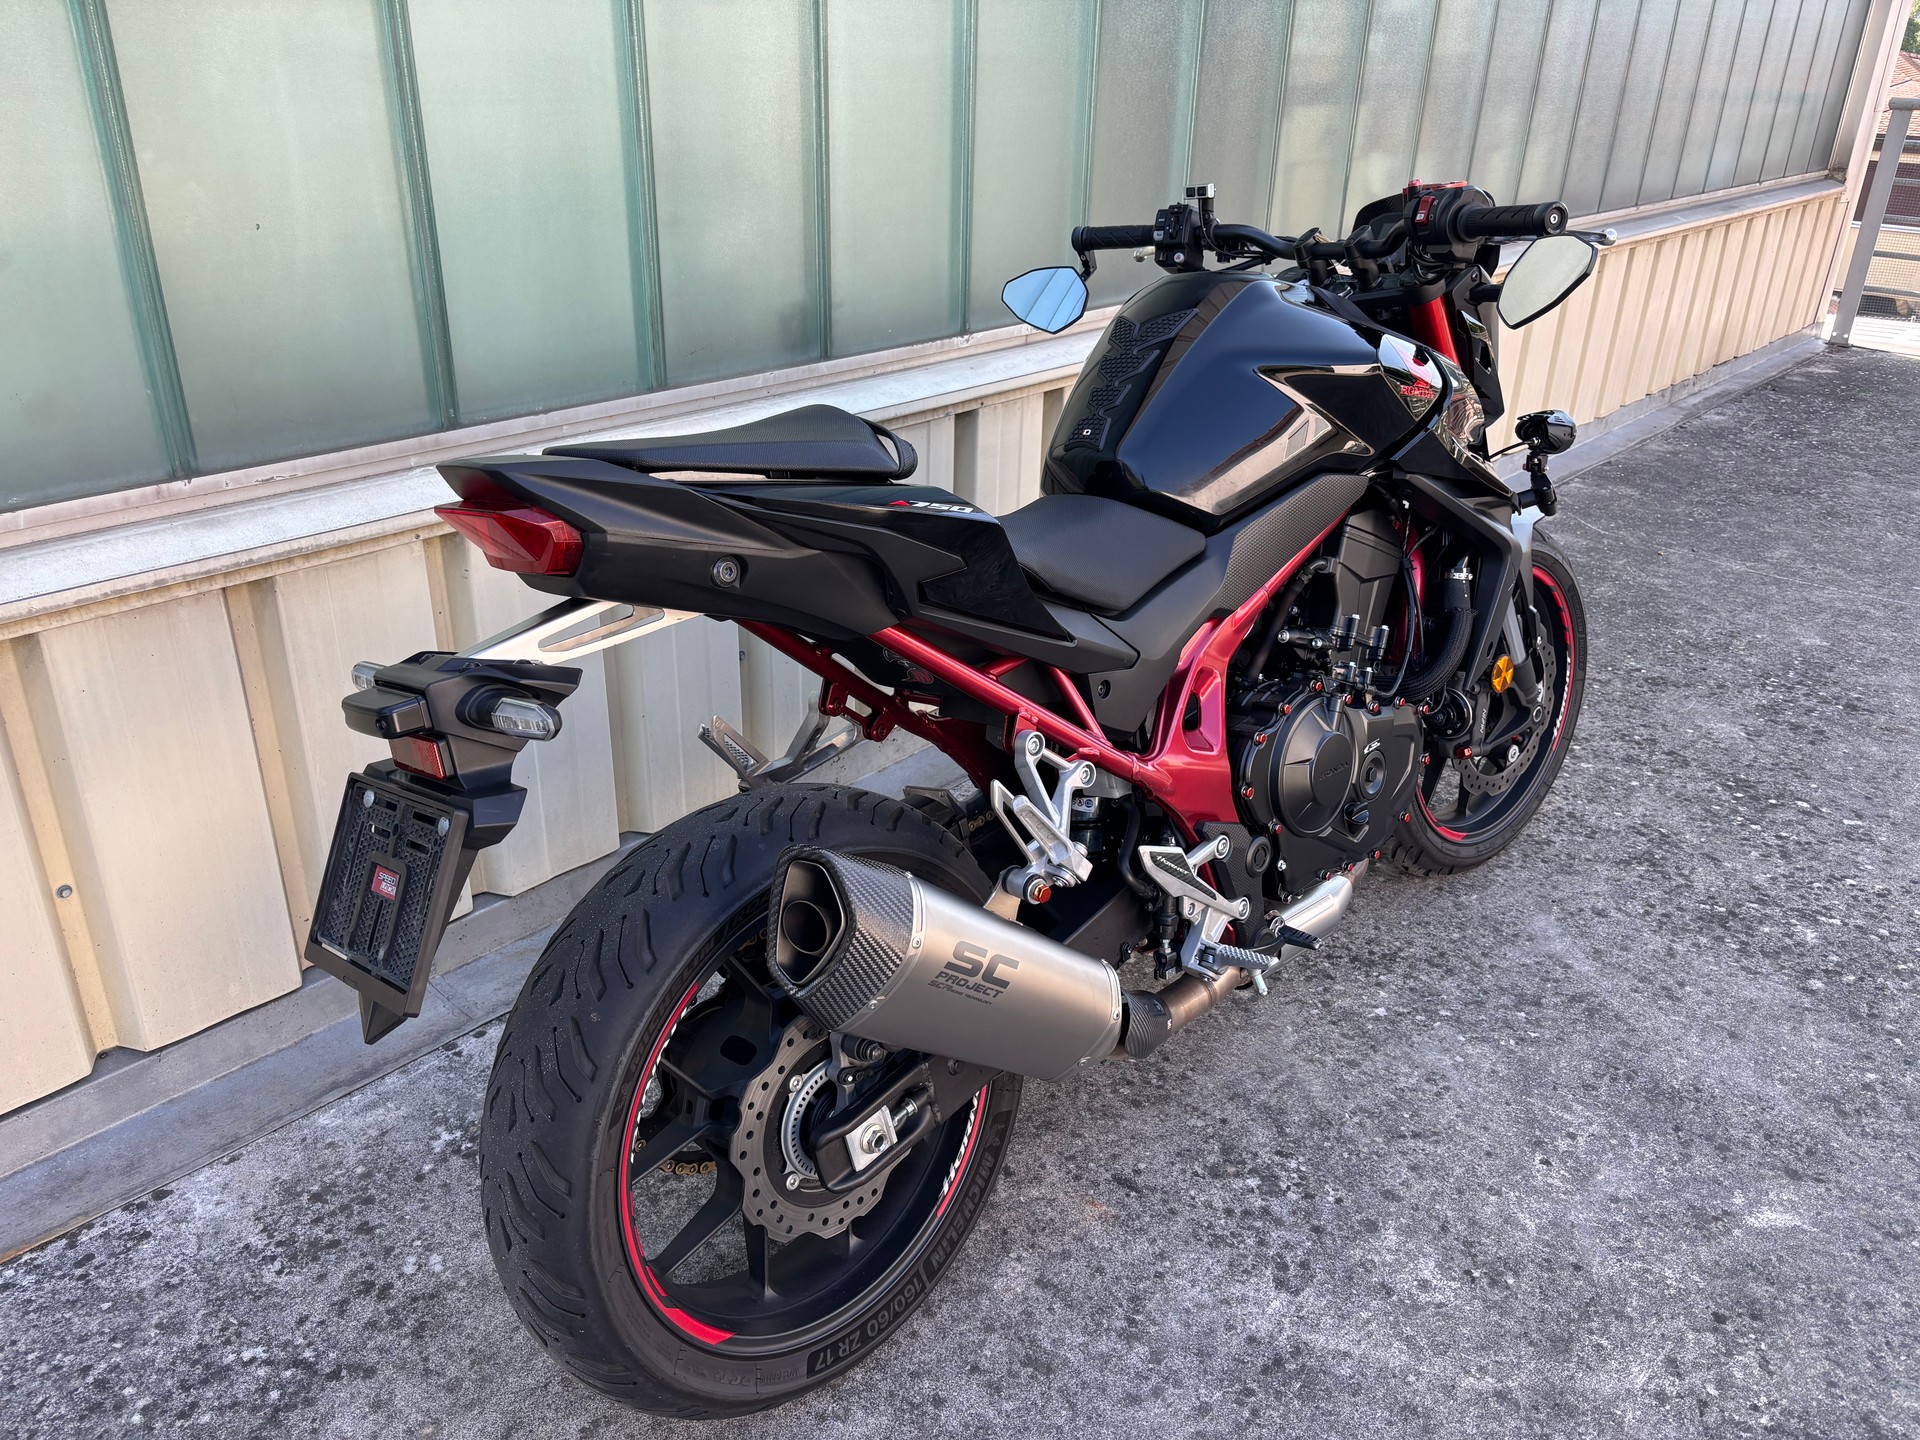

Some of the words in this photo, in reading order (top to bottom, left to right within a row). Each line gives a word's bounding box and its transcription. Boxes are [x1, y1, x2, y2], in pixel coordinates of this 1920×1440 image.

[909, 501, 973, 513] 750
[944, 940, 1020, 989] SC
[935, 971, 1004, 998] PROJECT
[930, 1152, 995, 1271] MICHELIN
[867, 1279, 922, 1337] 160/60
[838, 1330, 861, 1357] ZR
[815, 1348, 833, 1371] 17
